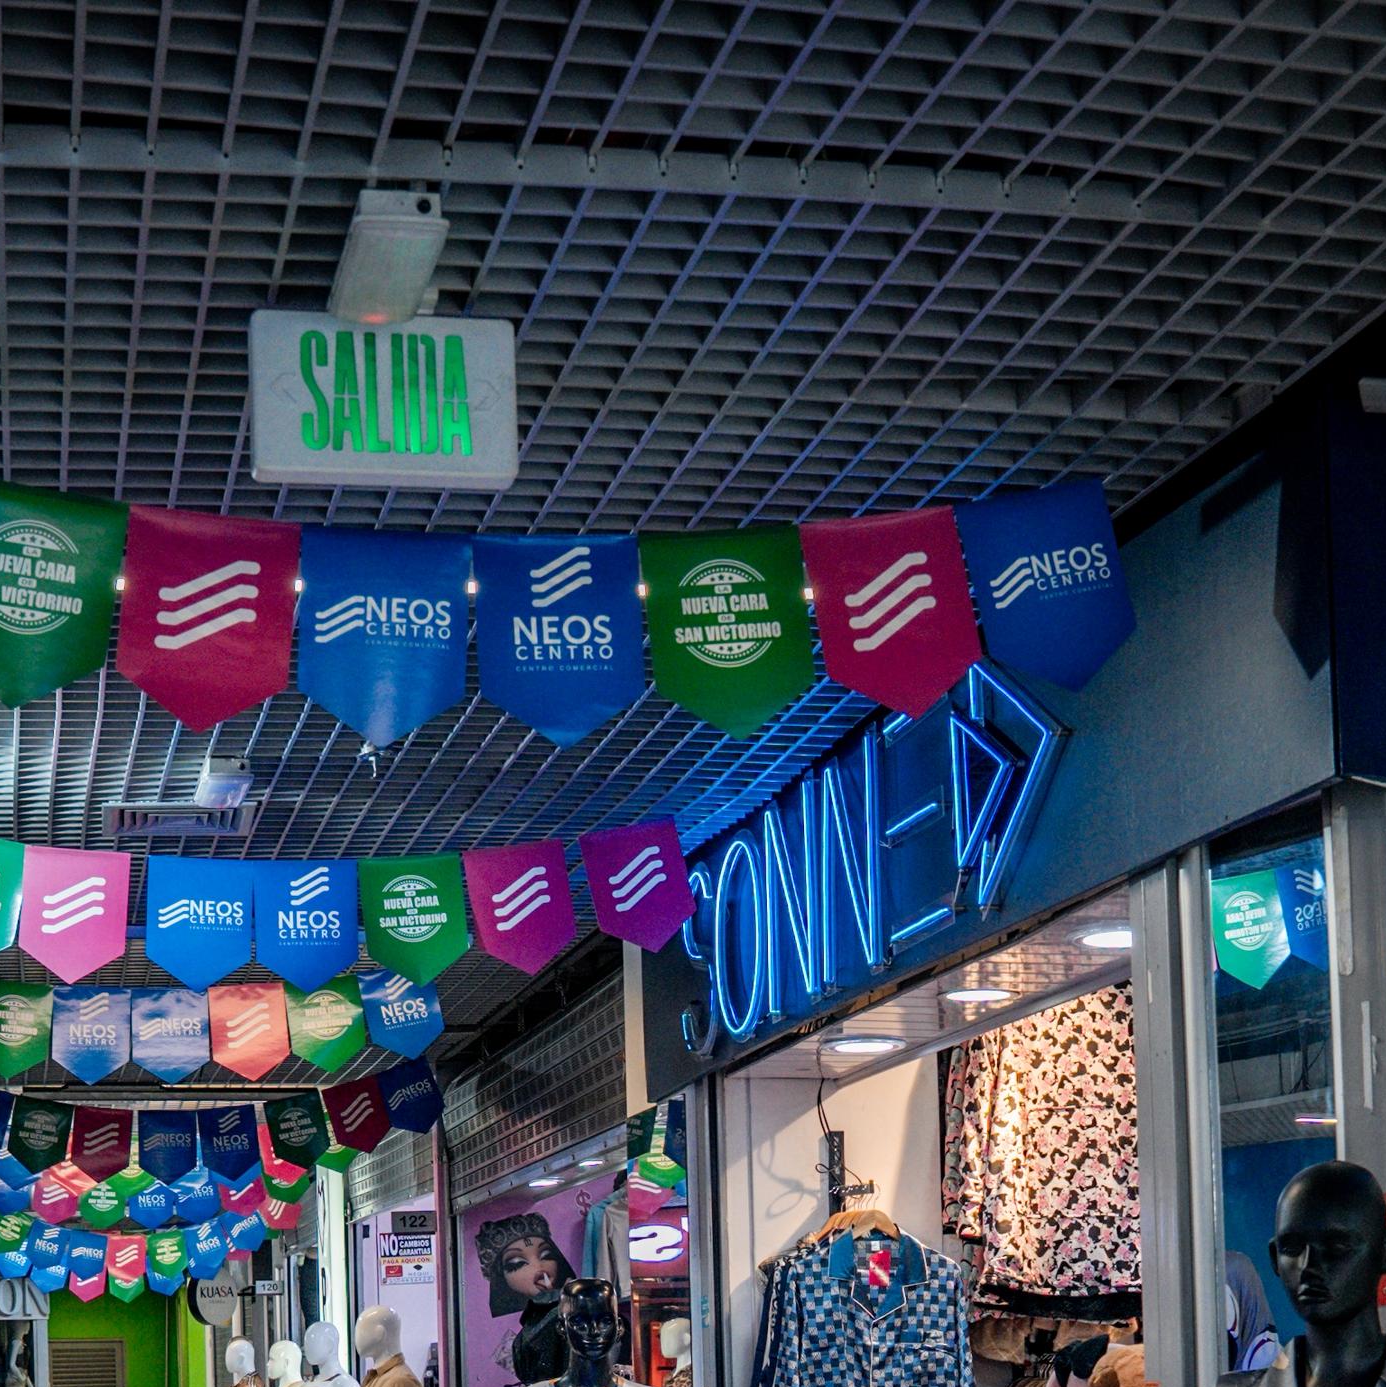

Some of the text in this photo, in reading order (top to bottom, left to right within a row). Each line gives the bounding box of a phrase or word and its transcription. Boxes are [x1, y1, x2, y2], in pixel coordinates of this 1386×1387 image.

[300, 330, 472, 456] SALIDA
[1030, 543, 1108, 578] NEOS
[35, 560, 76, 584] CARA
[1037, 566, 1111, 590] CENTRO
[1, 585, 83, 614] VICTORINO
[681, 593, 769, 615] NUEVA CARA
[366, 596, 451, 626] NEOS
[366, 622, 451, 640] CENTRO
[514, 615, 613, 645] NEOS
[675, 621, 781, 644] SAN VICTORINO
[516, 644, 613, 660] CENTRO
[190, 900, 243, 917] NEOS
[383, 895, 439, 909] NUEVA CARA
[190, 914, 243, 926] CENTRO
[278, 910, 340, 929] NEOS
[379, 913, 447, 928] SAN VICTORINO
[279, 928, 341, 939] CENTRO
[381, 997, 426, 1019] NEOS
[161, 1017, 201, 1029] NEOS
[383, 1011, 428, 1026] CENTRO
[69, 1024, 117, 1038] NEOS
[162, 1028, 202, 1036] CENTRO
[69, 1036, 116, 1046] CENTRO
[402, 1079, 431, 1097] NEOS
[162, 1133, 191, 1143] NEOS
[213, 1134, 249, 1147] NEOS
[214, 1144, 249, 1153] CENTRO
[138, 1194, 165, 1203] NEOS
[240, 1215, 258, 1227] NEOS
[400, 1215, 427, 1227] 122
[35, 1239, 59, 1251] NEOS
[196, 1237, 220, 1250] NEOS
[380, 1234, 399, 1256] NO
[399, 1240, 429, 1248] CAMBIOS
[398, 1247, 430, 1256] GARANTIAS
[200, 1285, 234, 1299] KUASA
[261, 1284, 278, 1292] 120
